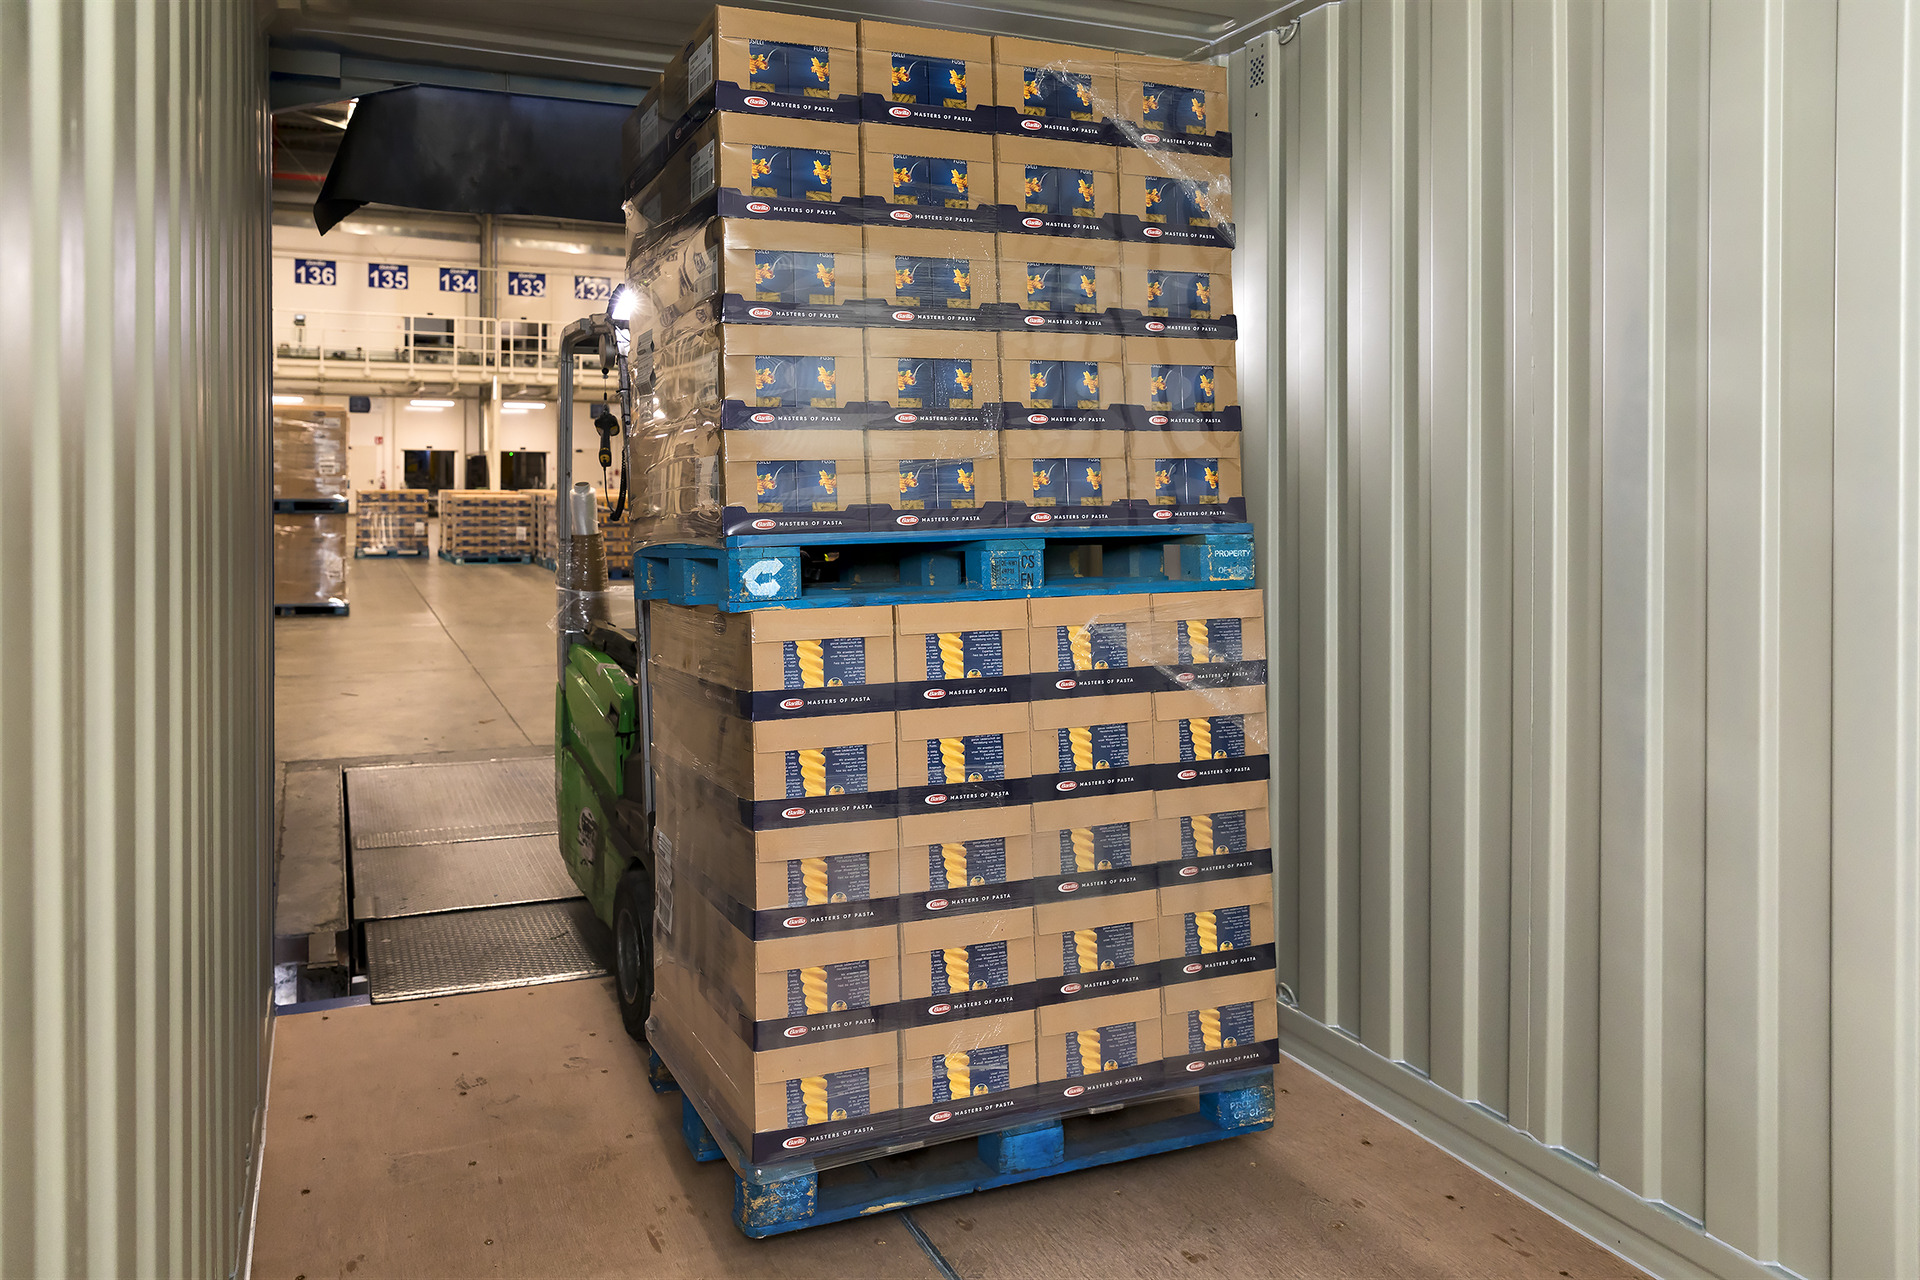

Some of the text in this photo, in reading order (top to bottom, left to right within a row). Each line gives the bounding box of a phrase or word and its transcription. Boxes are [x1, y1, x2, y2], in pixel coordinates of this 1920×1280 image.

[770, 100, 800, 109] MASTERS
[813, 105, 834, 113] PASTA
[913, 111, 941, 119] MASTERS
[296, 266, 334, 285] 136
[369, 270, 407, 289] 135
[441, 274, 477, 292] 134
[510, 279, 544, 296] 133
[576, 282, 610, 300] 132
[1022, 555, 1034, 568] CS
[1079, 779, 1105, 787] MASTERS
[809, 806, 839, 814] MASTERS
[1200, 864, 1225, 872] MASTERS
[1080, 879, 1107, 888] MASTERS
[950, 896, 979, 905] MASTERS
[810, 914, 840, 923] MASTERS
[1204, 960, 1229, 969] MASTERS
[1083, 979, 1110, 988] MASTERS
[953, 1000, 982, 1009] MASTERS
[994, 995, 1014, 1004] PASTA
[810, 1022, 841, 1032] MASTERS
[854, 1017, 876, 1025] PASTA
[1207, 1057, 1232, 1066] MASTERS
[1242, 1052, 1260, 1060] PASTA
[1086, 1081, 1113, 1091] MASTERS
[1124, 1075, 1142, 1084] PASTA
[954, 1106, 982, 1117] MASTERS
[995, 1099, 1014, 1109] PASTA
[809, 1131, 840, 1142] MASTERS
[853, 1125, 874, 1134] PASTA
